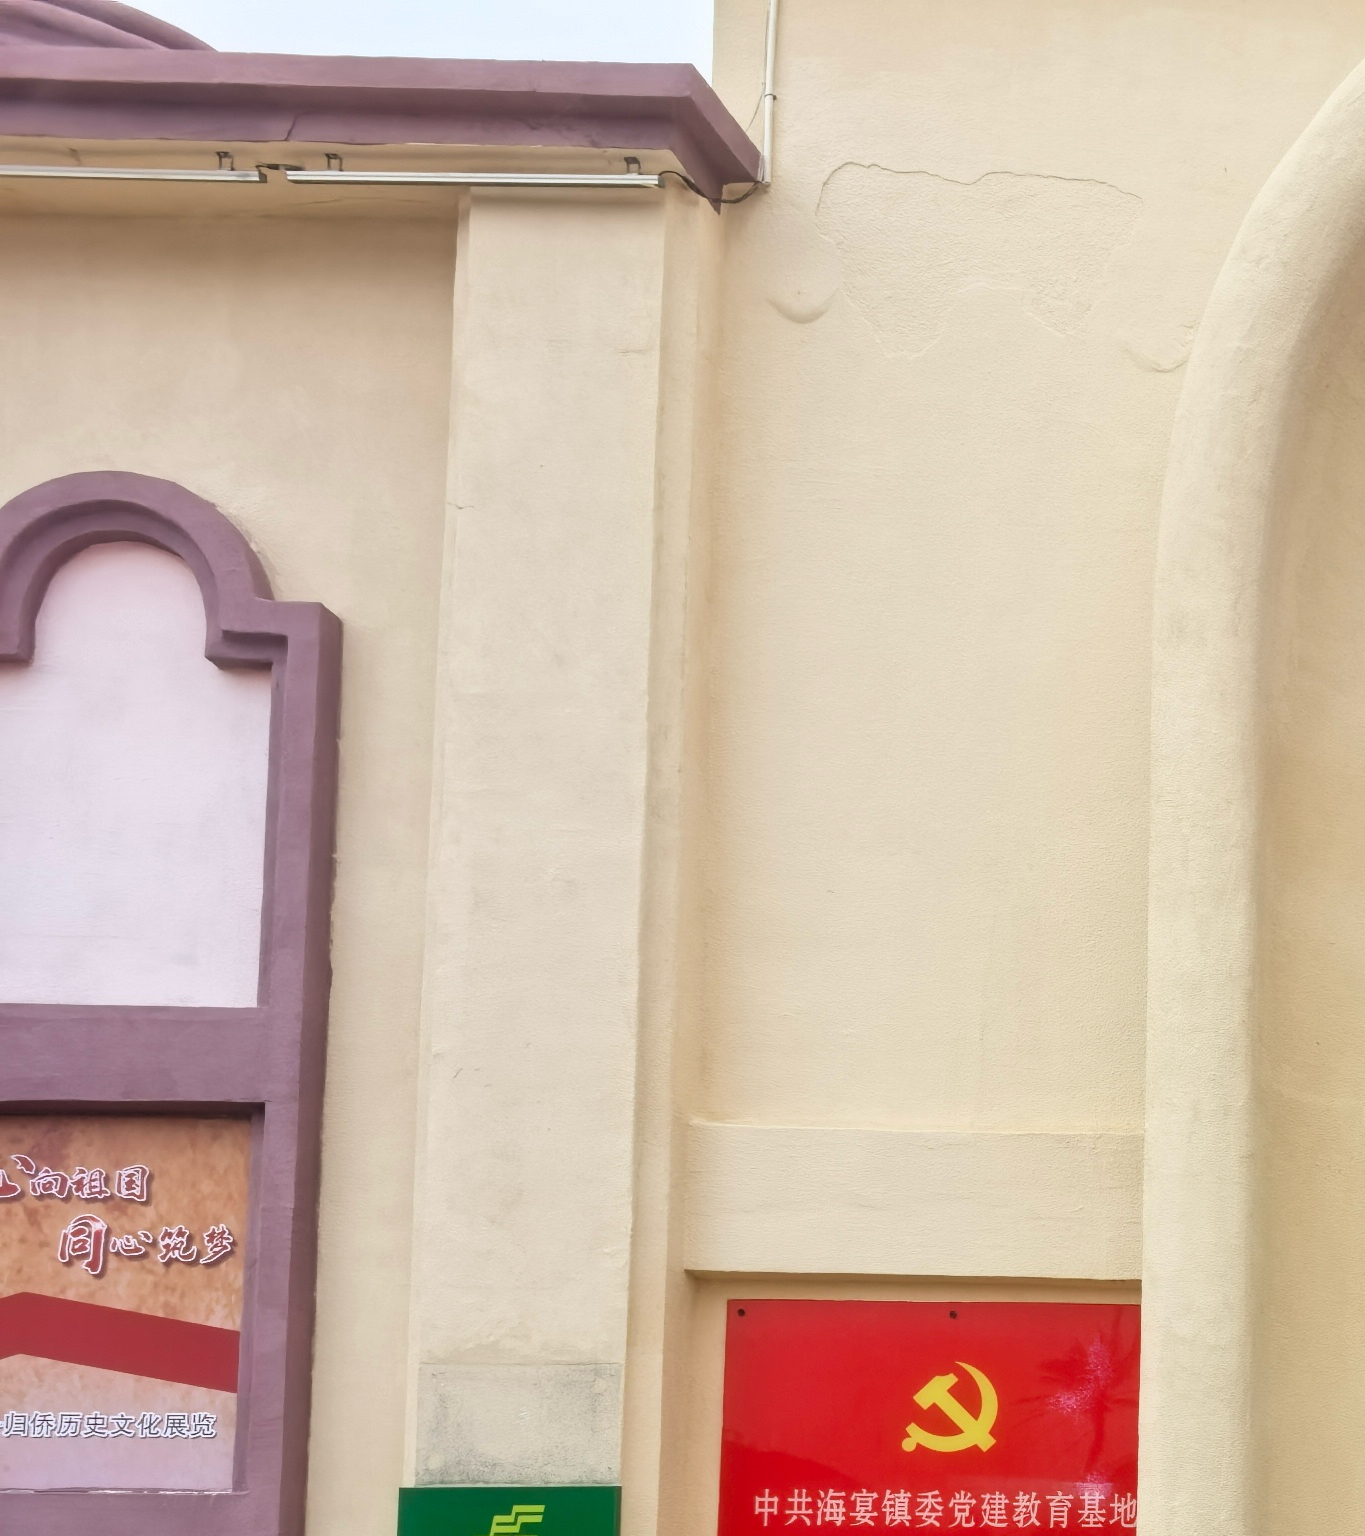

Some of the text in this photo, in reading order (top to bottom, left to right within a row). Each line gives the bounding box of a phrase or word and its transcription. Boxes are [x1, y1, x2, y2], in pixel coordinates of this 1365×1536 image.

[58, 1214, 237, 1275] 同心筑梦
[754, 1488, 1137, 1529] 中共海宴镇委党建教育基地
